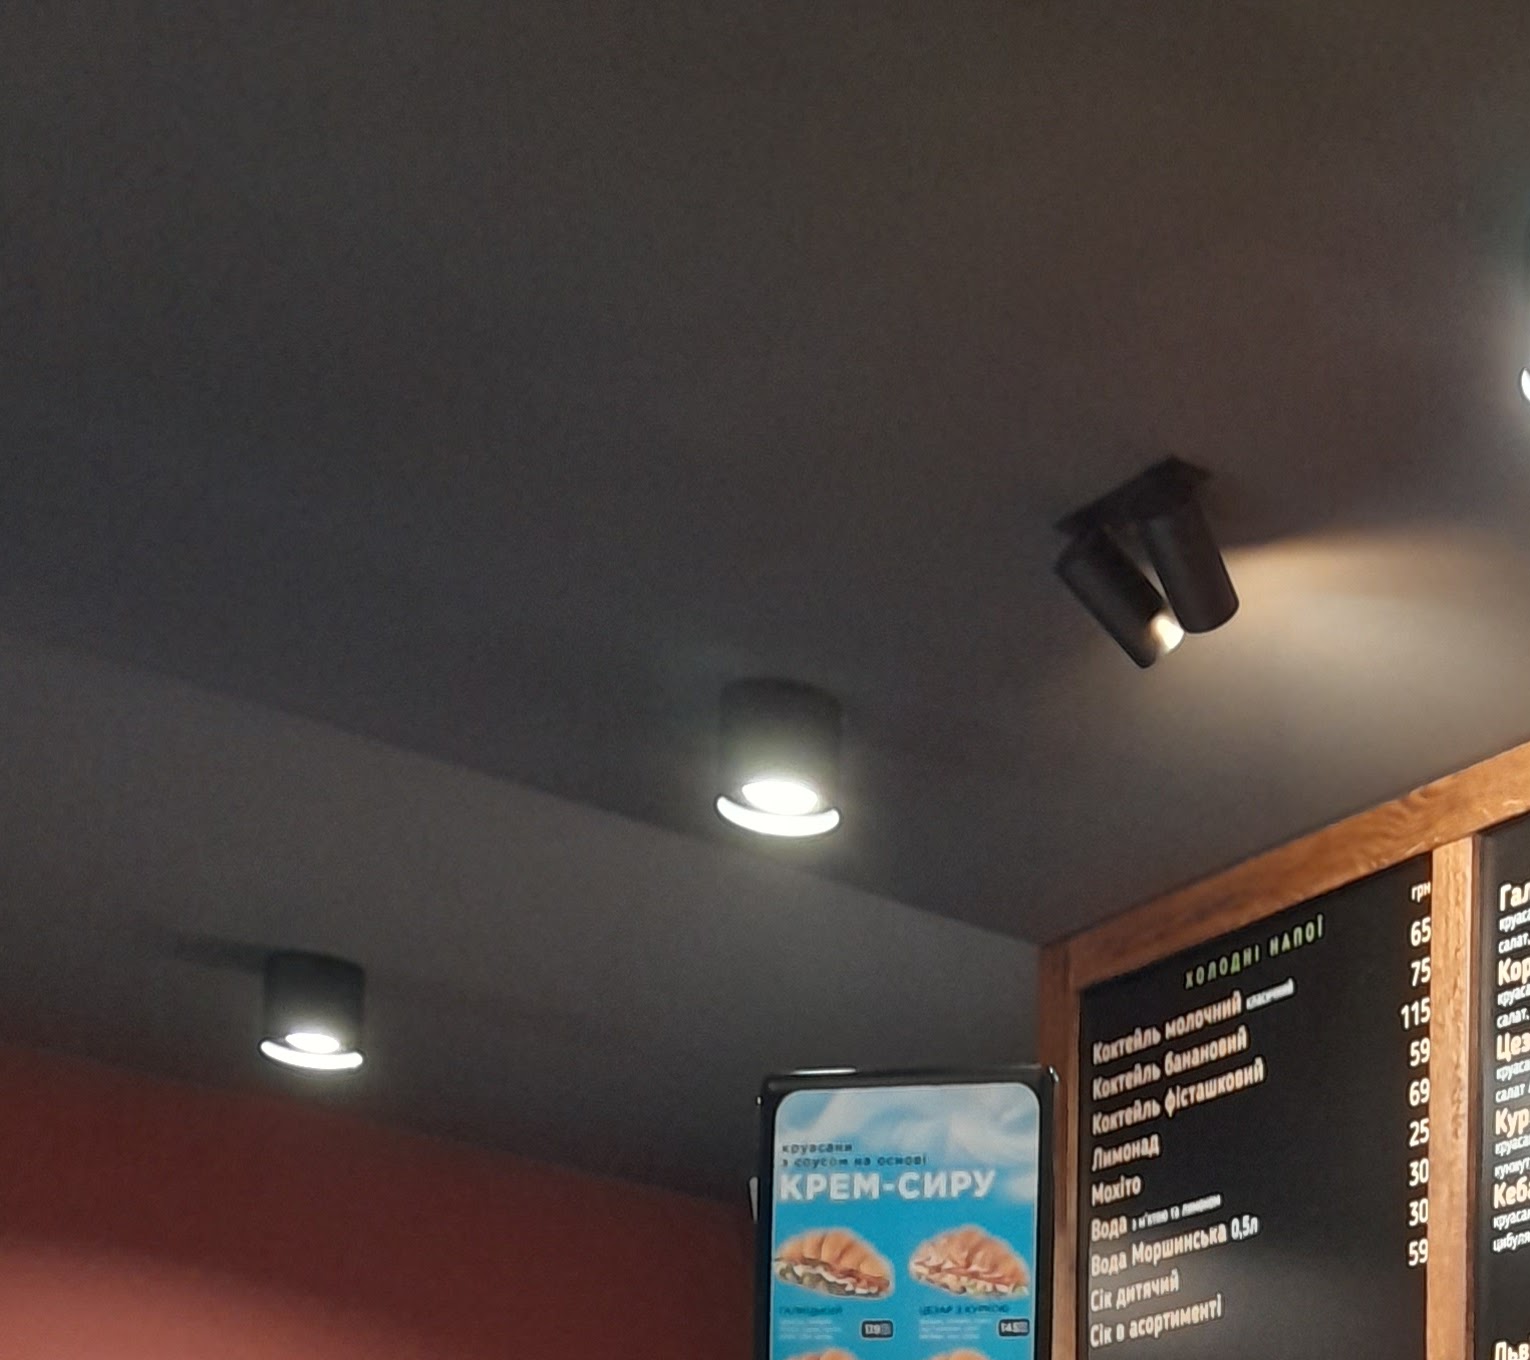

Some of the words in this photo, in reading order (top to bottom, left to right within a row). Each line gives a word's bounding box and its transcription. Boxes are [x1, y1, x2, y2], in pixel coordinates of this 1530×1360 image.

[1411, 880, 1431, 902] грн
[1411, 919, 1431, 946] 65
[1185, 944, 1260, 989] ХОЛОДНІ
[1269, 914, 1323, 956] НАПОЇ
[1411, 959, 1431, 986] 75
[1093, 1027, 1161, 1065] Коктейль
[1165, 990, 1242, 1039] молочний
[1401, 999, 1431, 1029] 115
[1092, 1063, 1161, 1100] Коктейль
[1164, 1025, 1247, 1076] банановий
[1410, 1040, 1430, 1067] 59
[1092, 1099, 1161, 1135] Коктейль
[1164, 1057, 1264, 1118] фісташковий
[1409, 1079, 1430, 1105] 69
[1408, 1119, 1429, 1146] 25
[877, 1152, 927, 1166] основі
[1091, 1134, 1160, 1172] Лимонад
[780, 1169, 996, 1200] КРЕМ-СИРУ
[1408, 1159, 1428, 1187] 30
[1091, 1175, 1142, 1206] Мохіто
[1408, 1199, 1428, 1226] 30
[1091, 1216, 1128, 1242] Вода
[1091, 1252, 1127, 1277] Вода
[1132, 1223, 1227, 1266] Моршинська
[1231, 1214, 1259, 1240] 0,5л
[1408, 1238, 1428, 1266] 59
[1090, 1288, 1113, 1312] Сік
[1115, 1268, 1179, 1310] дитячий
[1090, 1323, 1112, 1348] Сік
[1129, 1293, 1222, 1339] асортименті
